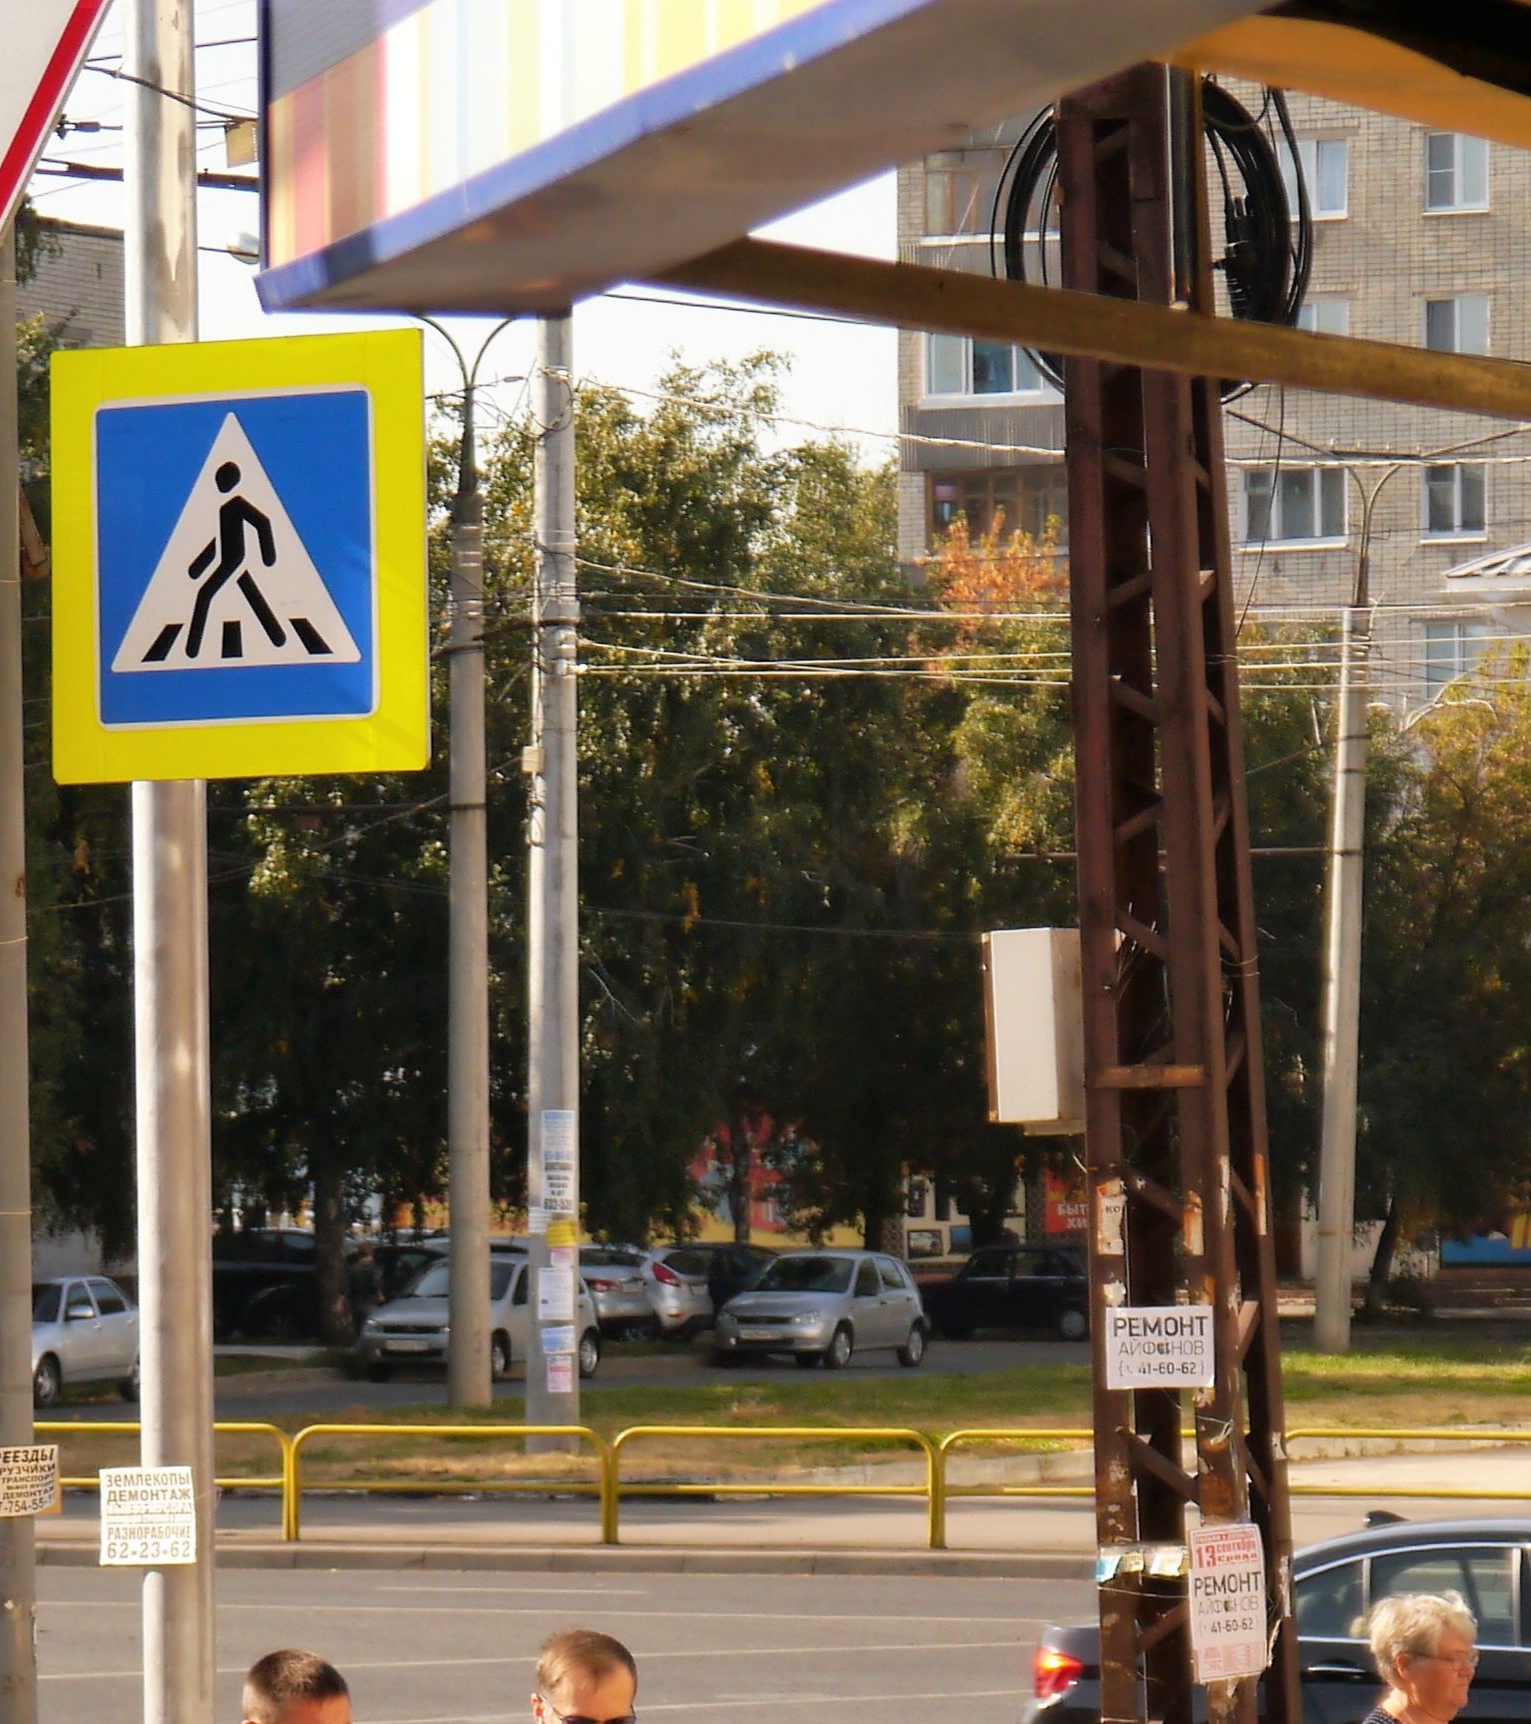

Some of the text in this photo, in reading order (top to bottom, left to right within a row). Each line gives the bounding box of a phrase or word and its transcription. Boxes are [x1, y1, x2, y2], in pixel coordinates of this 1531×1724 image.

[1113, 1316, 1209, 1337] РЕМОНТ
[107, 1487, 192, 1506] ДЕМОНТАЖ
[107, 1525, 191, 1540] РАЗНОРАБОЧИЕ
[107, 1541, 191, 1559] 62-23-62
[1196, 1544, 1217, 1569] 13
[1194, 1571, 1261, 1598] РЕМОНТ
